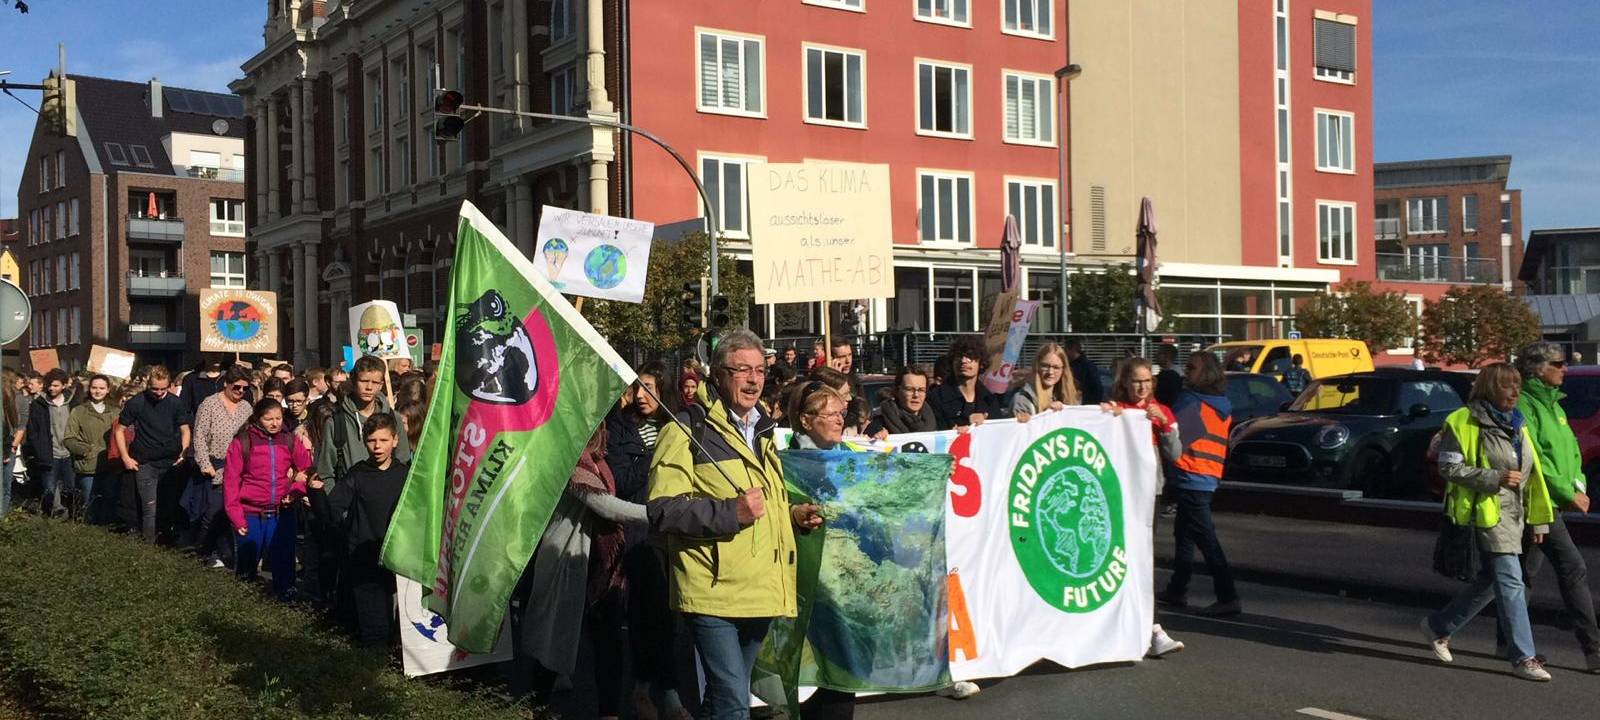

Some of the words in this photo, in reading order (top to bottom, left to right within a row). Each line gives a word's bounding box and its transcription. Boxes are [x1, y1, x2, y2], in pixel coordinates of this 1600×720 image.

[769, 169, 809, 192] DAS
[819, 168, 871, 193] KLIMA
[769, 210, 845, 226] aussichtsloser
[800, 236, 822, 247] als
[826, 236, 855, 246] unser
[768, 254, 888, 291] MATHE-ABI
[1012, 434, 1070, 528] FRIDAYS
[1073, 434, 1106, 477] FOR
[1063, 545, 1128, 608] FUTURE
